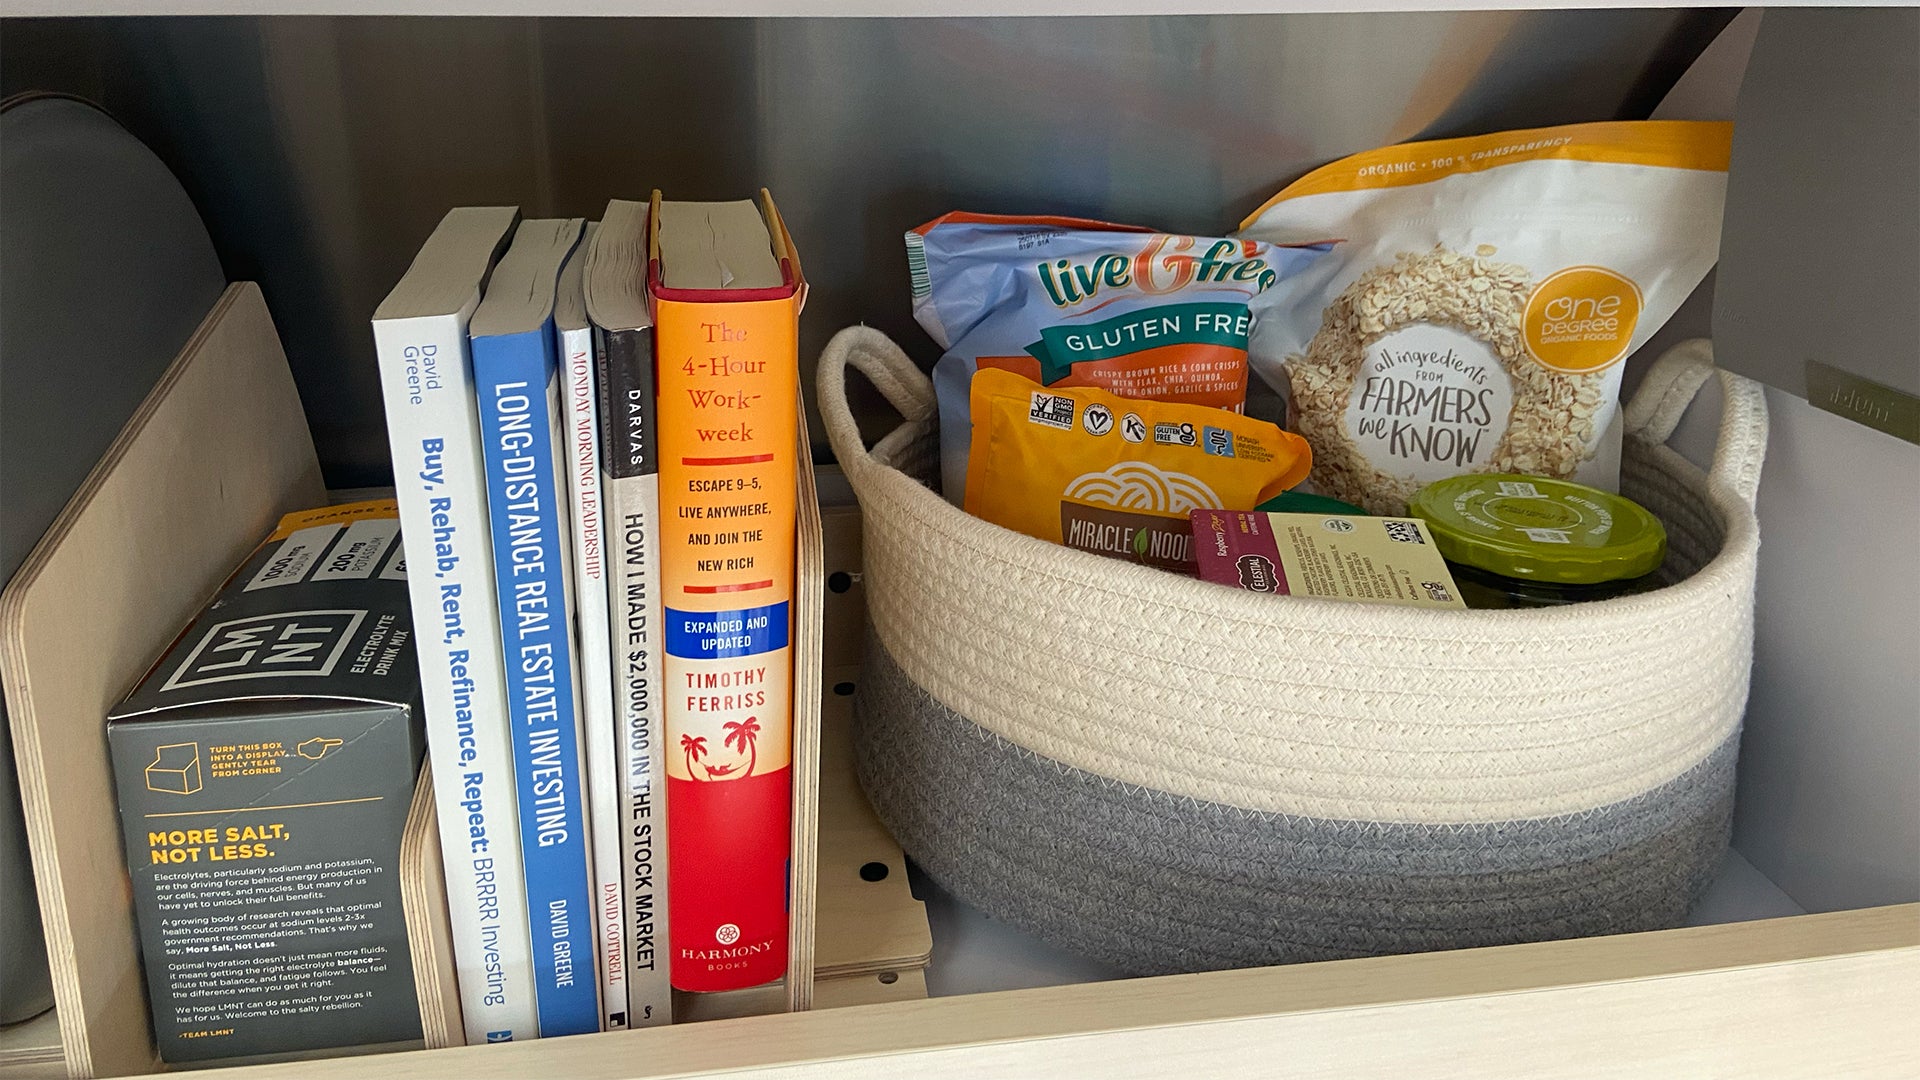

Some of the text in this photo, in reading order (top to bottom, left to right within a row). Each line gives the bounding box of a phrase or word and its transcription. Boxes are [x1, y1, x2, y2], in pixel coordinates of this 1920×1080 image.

[1358, 161, 1416, 177] ORGANIC
[1431, 157, 1453, 169] 100
[1470, 136, 1574, 161] TRANSPARENCY
[700, 321, 748, 343] The
[1066, 314, 1249, 351] GLUTEN FRE
[1540, 332, 1618, 345] ORGANIC FOODS
[403, 346, 423, 405] Greene
[421, 344, 443, 390] David
[682, 355, 767, 377] 4-Hour
[1093, 360, 1240, 378] CRISPY BROWN RICE & CORN CRISPS
[1374, 348, 1488, 385] all ingredients
[1415, 370, 1444, 383] FROM
[1112, 373, 1224, 387] WITH FLAX, CHIA, QUINOA,
[1127, 387, 1137, 396] OF
[1174, 384, 1202, 393] GARLIC
[1206, 383, 1211, 392] &
[1214, 382, 1239, 392] SPICES
[687, 389, 762, 409] Work-
[1054, 396, 1073, 405] NON
[1054, 403, 1073, 411] GMO
[1359, 376, 1494, 426] FARMERS
[628, 389, 643, 465] DARVAS
[1032, 410, 1072, 424] VERIFIED
[696, 421, 754, 442] week
[1156, 427, 1180, 435] GLUTEN
[1359, 417, 1388, 440] we
[572, 351, 600, 580] MONDAY MORNING LEADERSHIP
[689, 479, 733, 492] ESCAPE
[678, 502, 772, 519] LIVE ANYWHERE,
[625, 513, 644, 564] HOW
[688, 529, 763, 546] AND JOIN THE
[1068, 518, 1134, 554] MIRACLE
[328, 542, 367, 572] 200 mg
[697, 556, 754, 571] NEW RICH
[261, 558, 294, 582] 1000
[1249, 558, 1269, 592] CELESTIAL
[495, 381, 568, 847] LONG-DISTANCE REAL ESTATE INVESTING
[627, 583, 647, 645] MADE
[684, 616, 768, 634] EXPANDED AND
[261, 623, 335, 664] NT
[350, 615, 395, 674] ELECTROLYTE
[373, 630, 409, 676] DRINK MIX
[701, 635, 752, 650] UPDATED
[686, 667, 766, 689] TIMOTHY
[626, 649, 650, 750] $2,000,000
[687, 691, 765, 712] FERRISS
[419, 438, 507, 1006] Buy, Rehab, Rent, Refinance, Repeat: BRRRR Investing
[209, 742, 282, 754] TURN THIS BOX
[210, 753, 234, 762] INTO
[211, 758, 276, 770] GENTLY TEAR
[212, 766, 282, 778] FROM CORNER
[630, 756, 650, 773] IN
[633, 781, 651, 820] THE
[148, 824, 290, 847] MORE SALT,
[151, 843, 275, 865] NOT LESS.
[633, 824, 653, 890] STOCK
[154, 858, 375, 881] Electrolytes, particularly sodium and potassium,
[156, 865, 383, 891] are the driving force behind energy production in
[175, 891, 199, 899] cells,
[200, 889, 234, 898] nerves,
[236, 887, 253, 895] and
[255, 884, 295, 894] muscles.
[297, 883, 314, 891] But
[316, 880, 342, 889] many
[344, 878, 354, 886] of
[158, 891, 326, 910] have yet to unlock their full benefits.
[604, 882, 622, 985] DAVID COTTRELL
[635, 895, 655, 970] MARKET
[549, 899, 574, 989] DAVID GREENE
[682, 939, 774, 960] HARMONY
[707, 961, 748, 971] BOOKS
